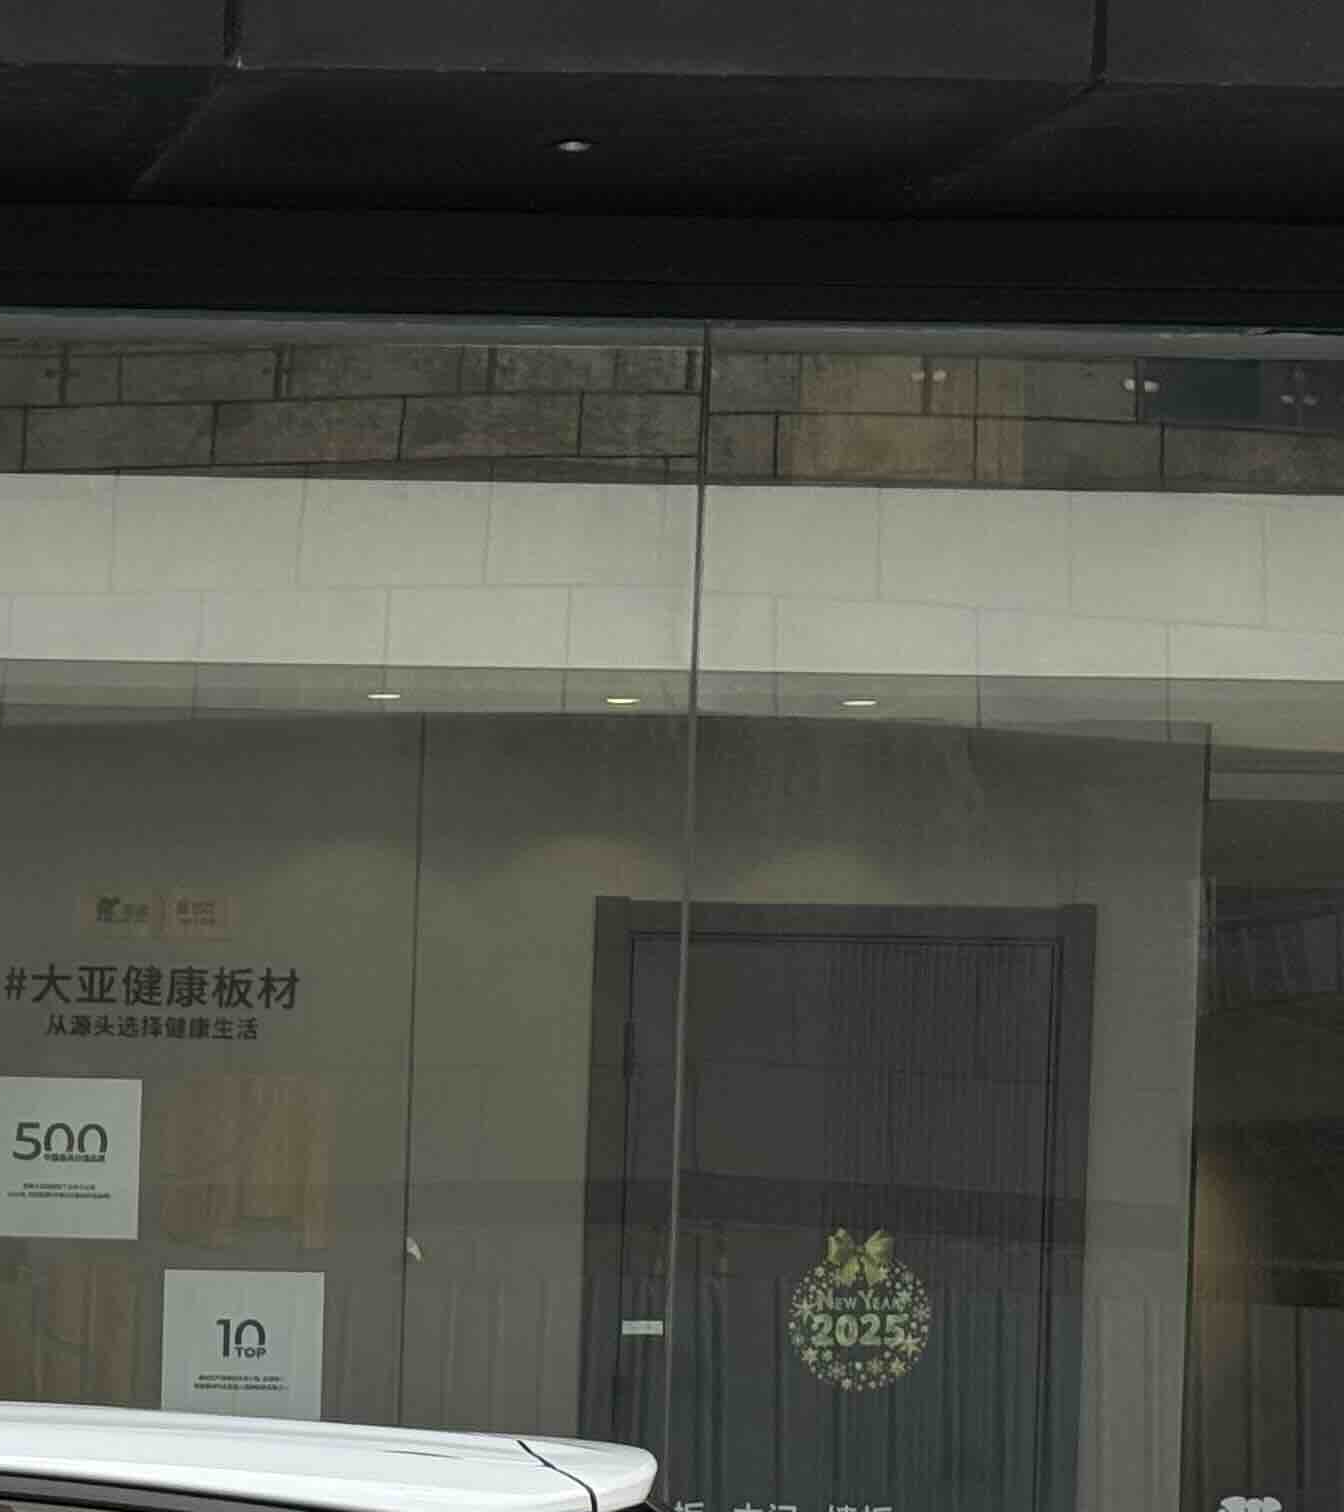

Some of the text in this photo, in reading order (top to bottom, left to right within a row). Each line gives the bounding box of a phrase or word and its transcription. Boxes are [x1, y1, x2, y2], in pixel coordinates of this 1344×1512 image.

[4, 963, 300, 1009] #大亚健康板材
[45, 1012, 259, 1040] 从源头选择健康生活
[12, 1121, 108, 1160] 500
[216, 1319, 266, 1357] 10
[812, 1313, 909, 1346] 2025
[234, 1347, 267, 1359] TOP
